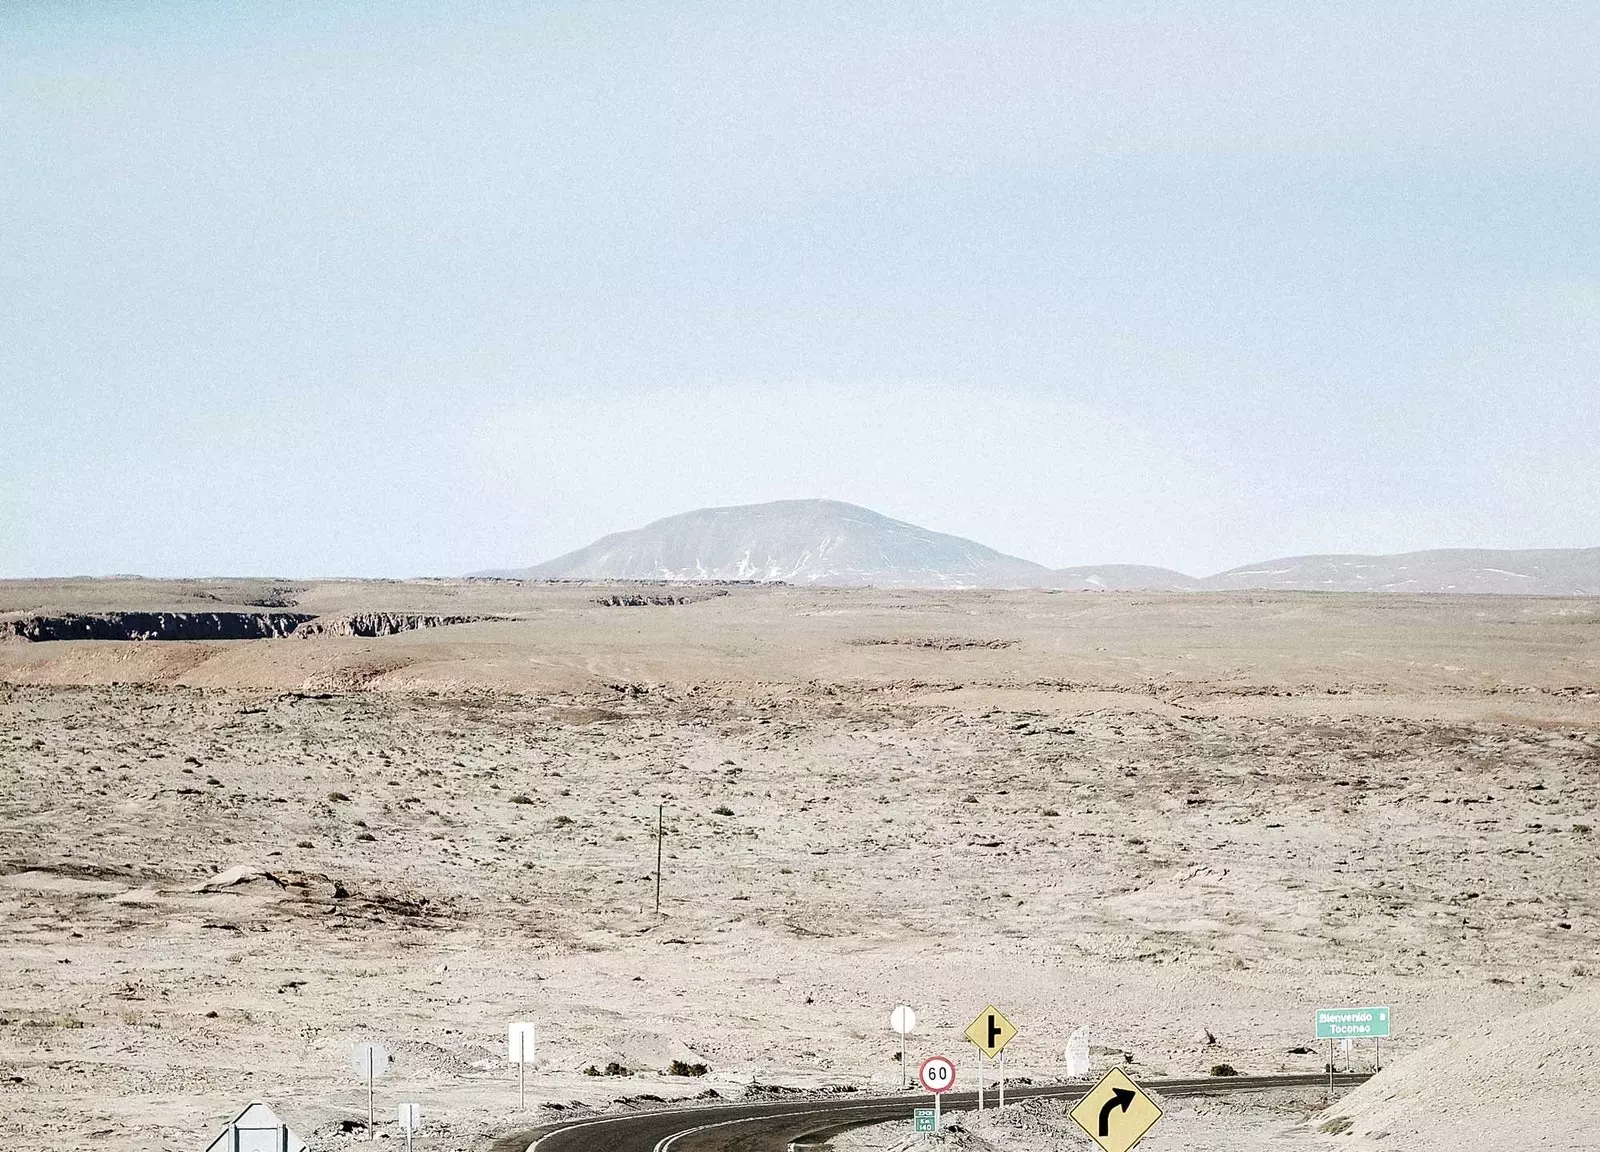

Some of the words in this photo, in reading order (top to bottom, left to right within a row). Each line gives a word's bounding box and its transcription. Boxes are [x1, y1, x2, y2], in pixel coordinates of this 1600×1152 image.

[1319, 1012, 1372, 1023] Bienvenido
[1330, 1024, 1371, 1034] Toconao
[928, 1066, 947, 1080] 60
